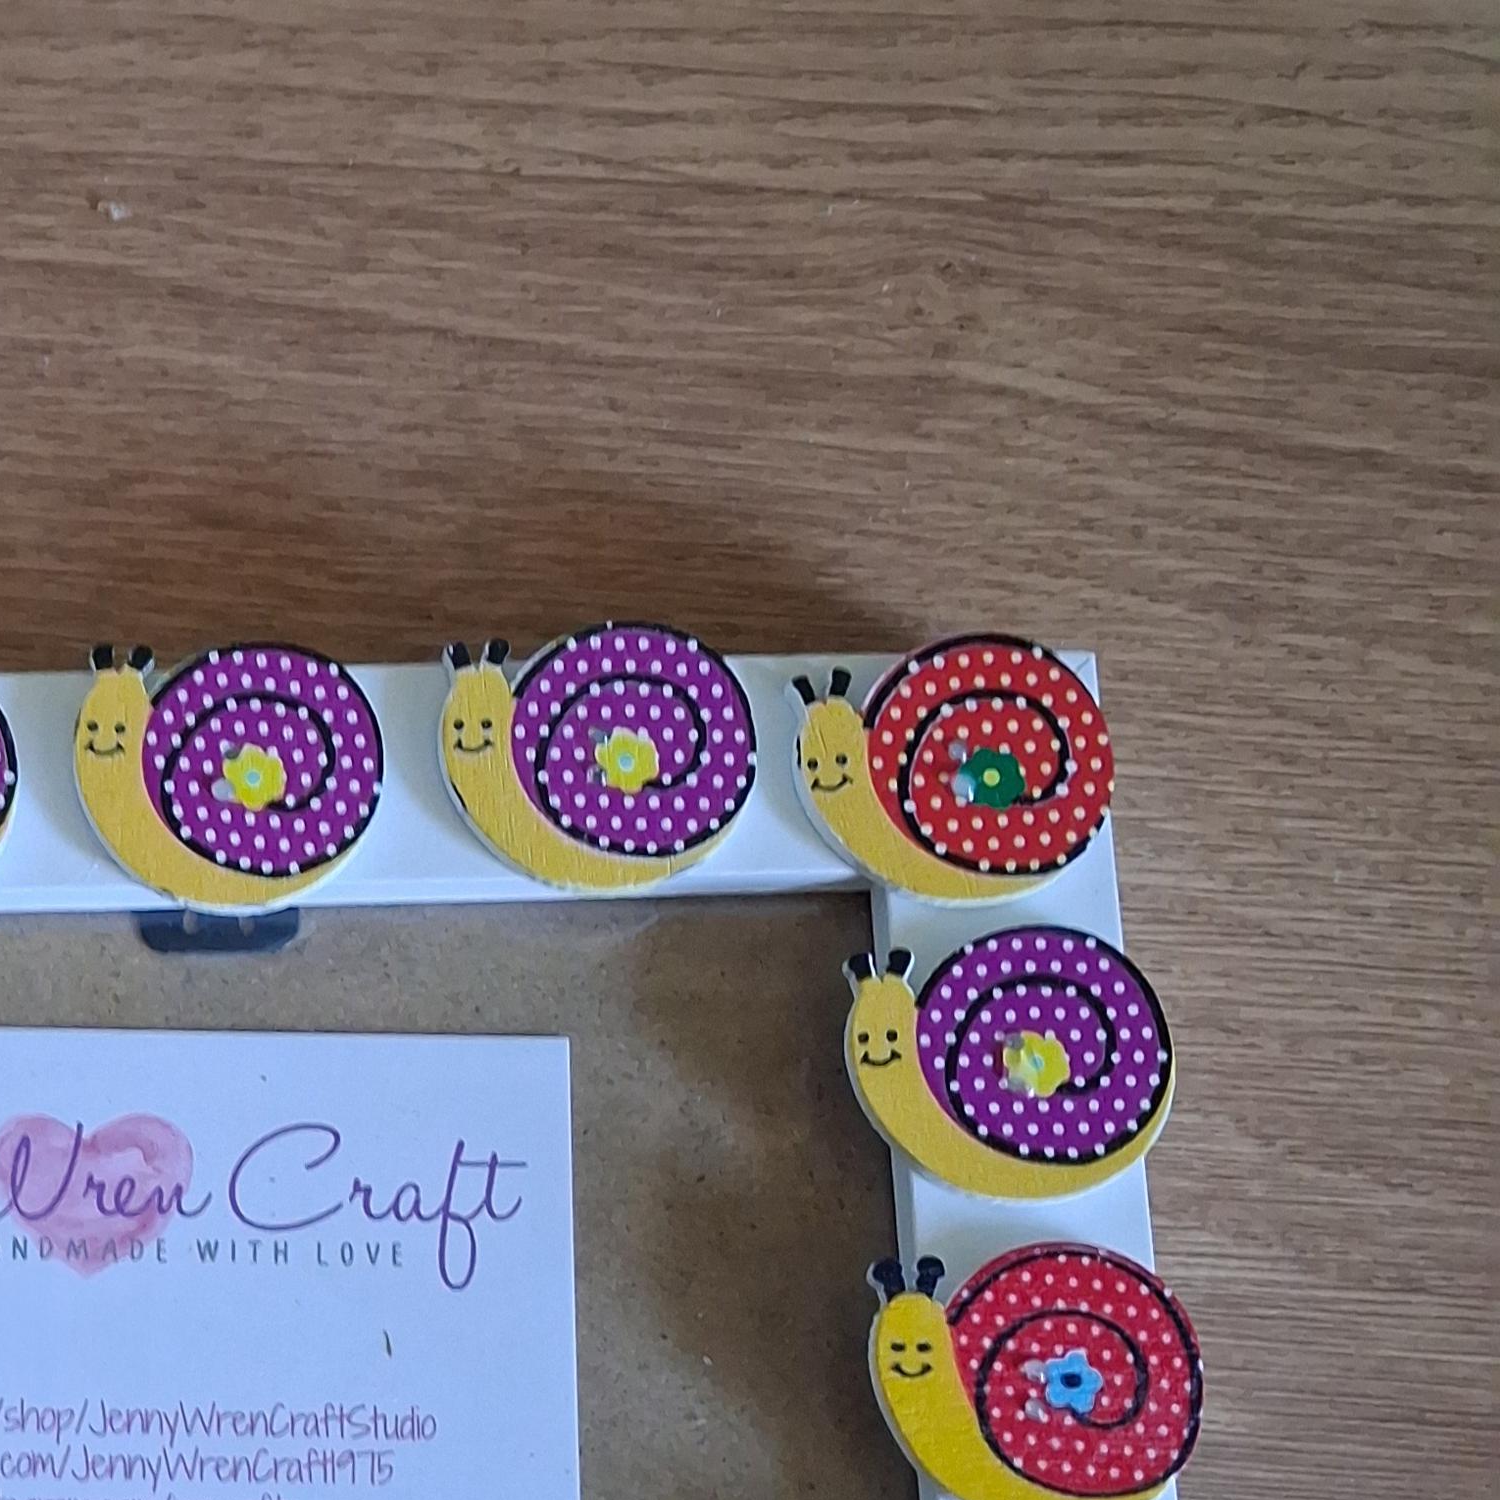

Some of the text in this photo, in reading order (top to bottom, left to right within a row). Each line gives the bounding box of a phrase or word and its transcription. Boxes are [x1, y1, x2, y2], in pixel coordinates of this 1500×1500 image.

[196, 1240, 292, 1267] WITH
[316, 1241, 406, 1269] LOVE
[229, 1122, 529, 1290] Craft
